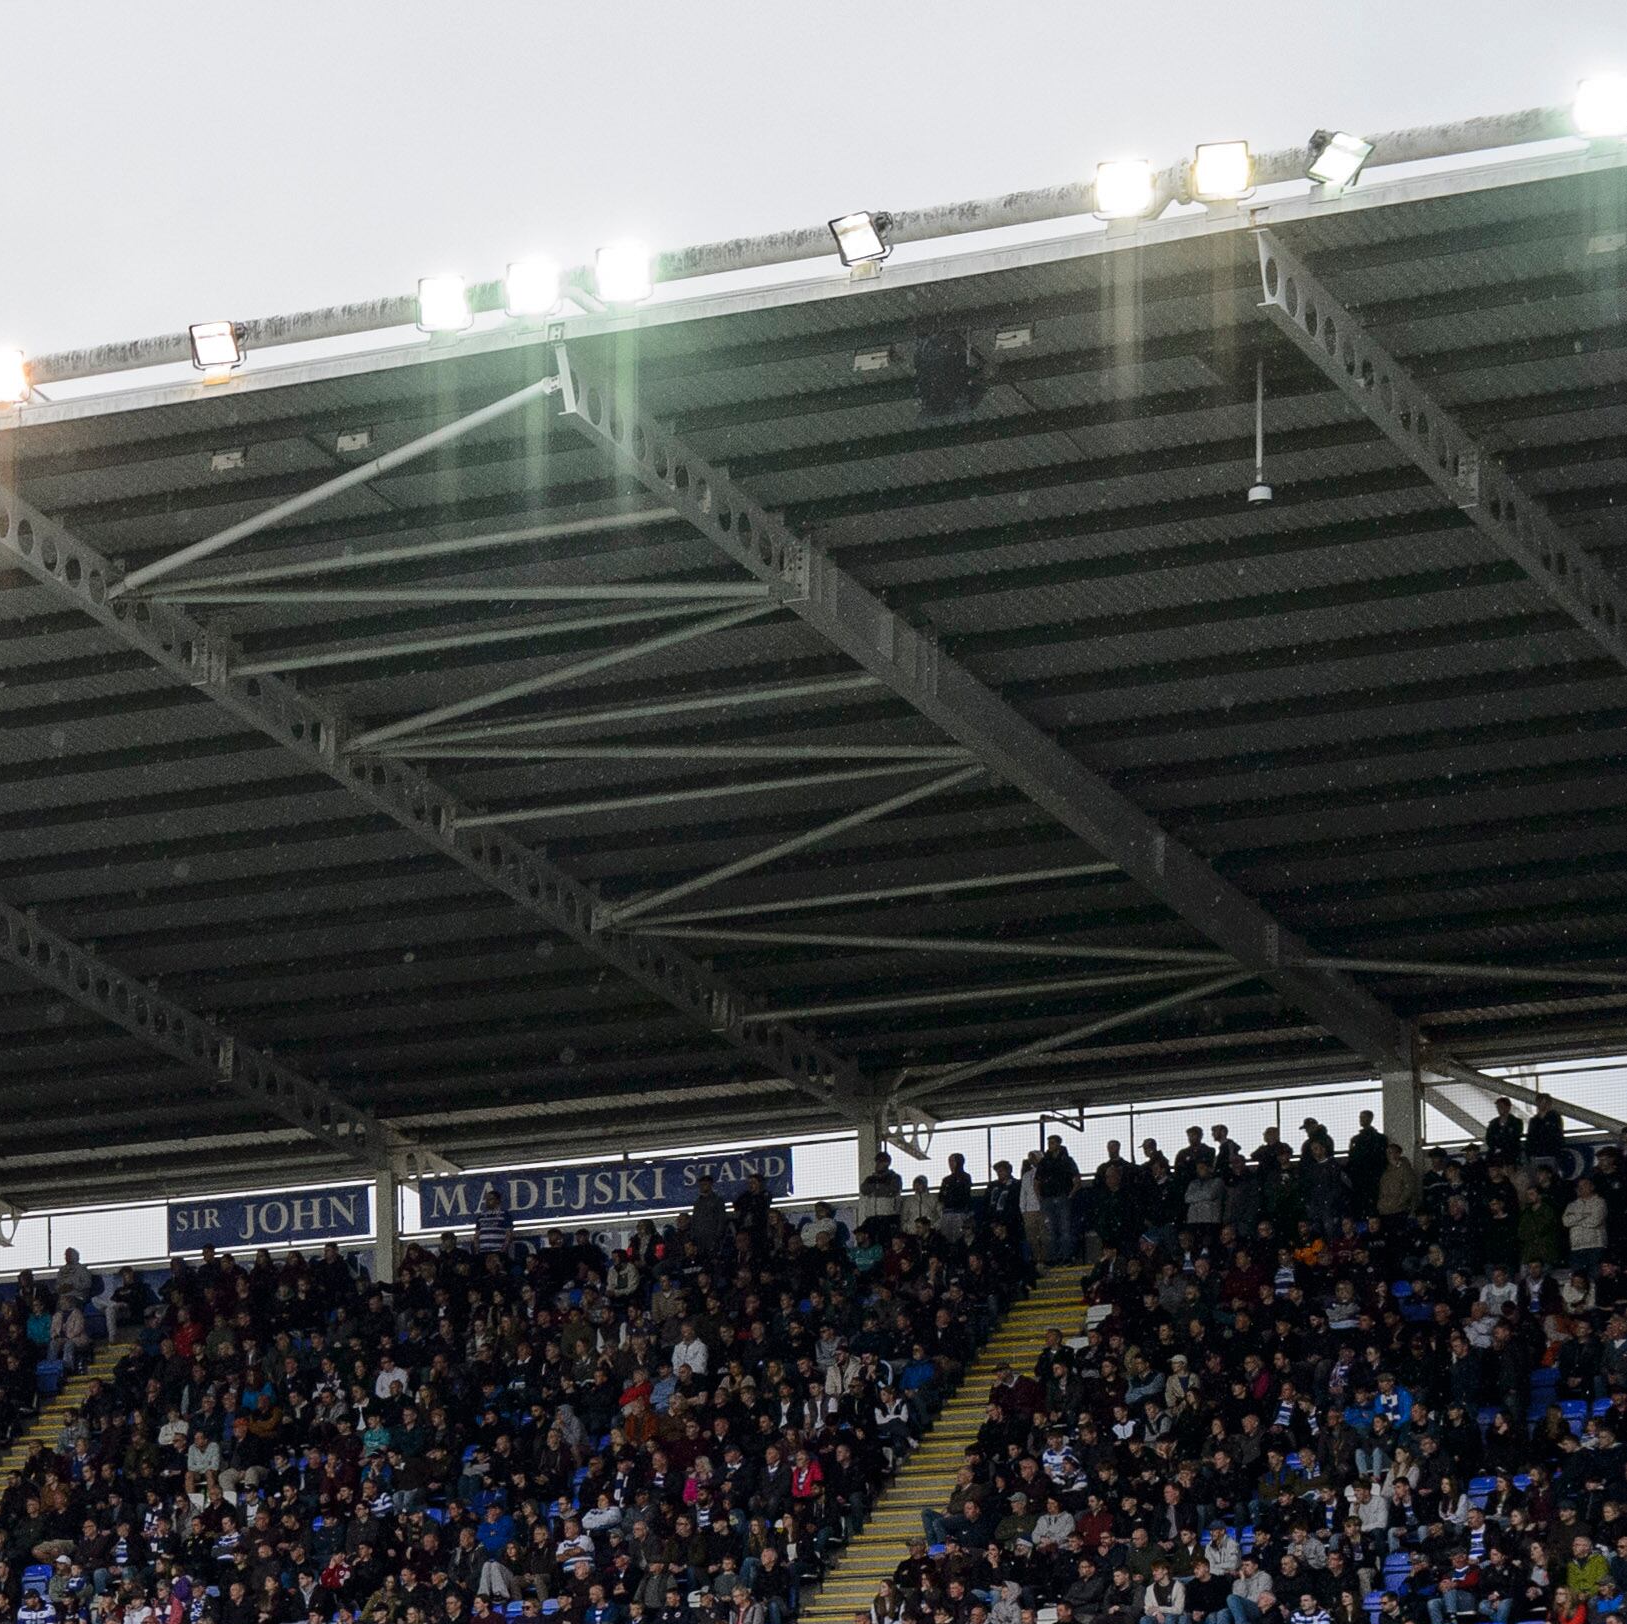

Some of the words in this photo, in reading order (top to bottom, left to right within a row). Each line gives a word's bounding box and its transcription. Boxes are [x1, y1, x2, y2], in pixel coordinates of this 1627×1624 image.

[430, 1166, 667, 1219] MADEJSKI
[683, 1156, 786, 1187] STAND
[176, 1207, 222, 1232] SIR
[239, 1194, 359, 1239] JOHN
